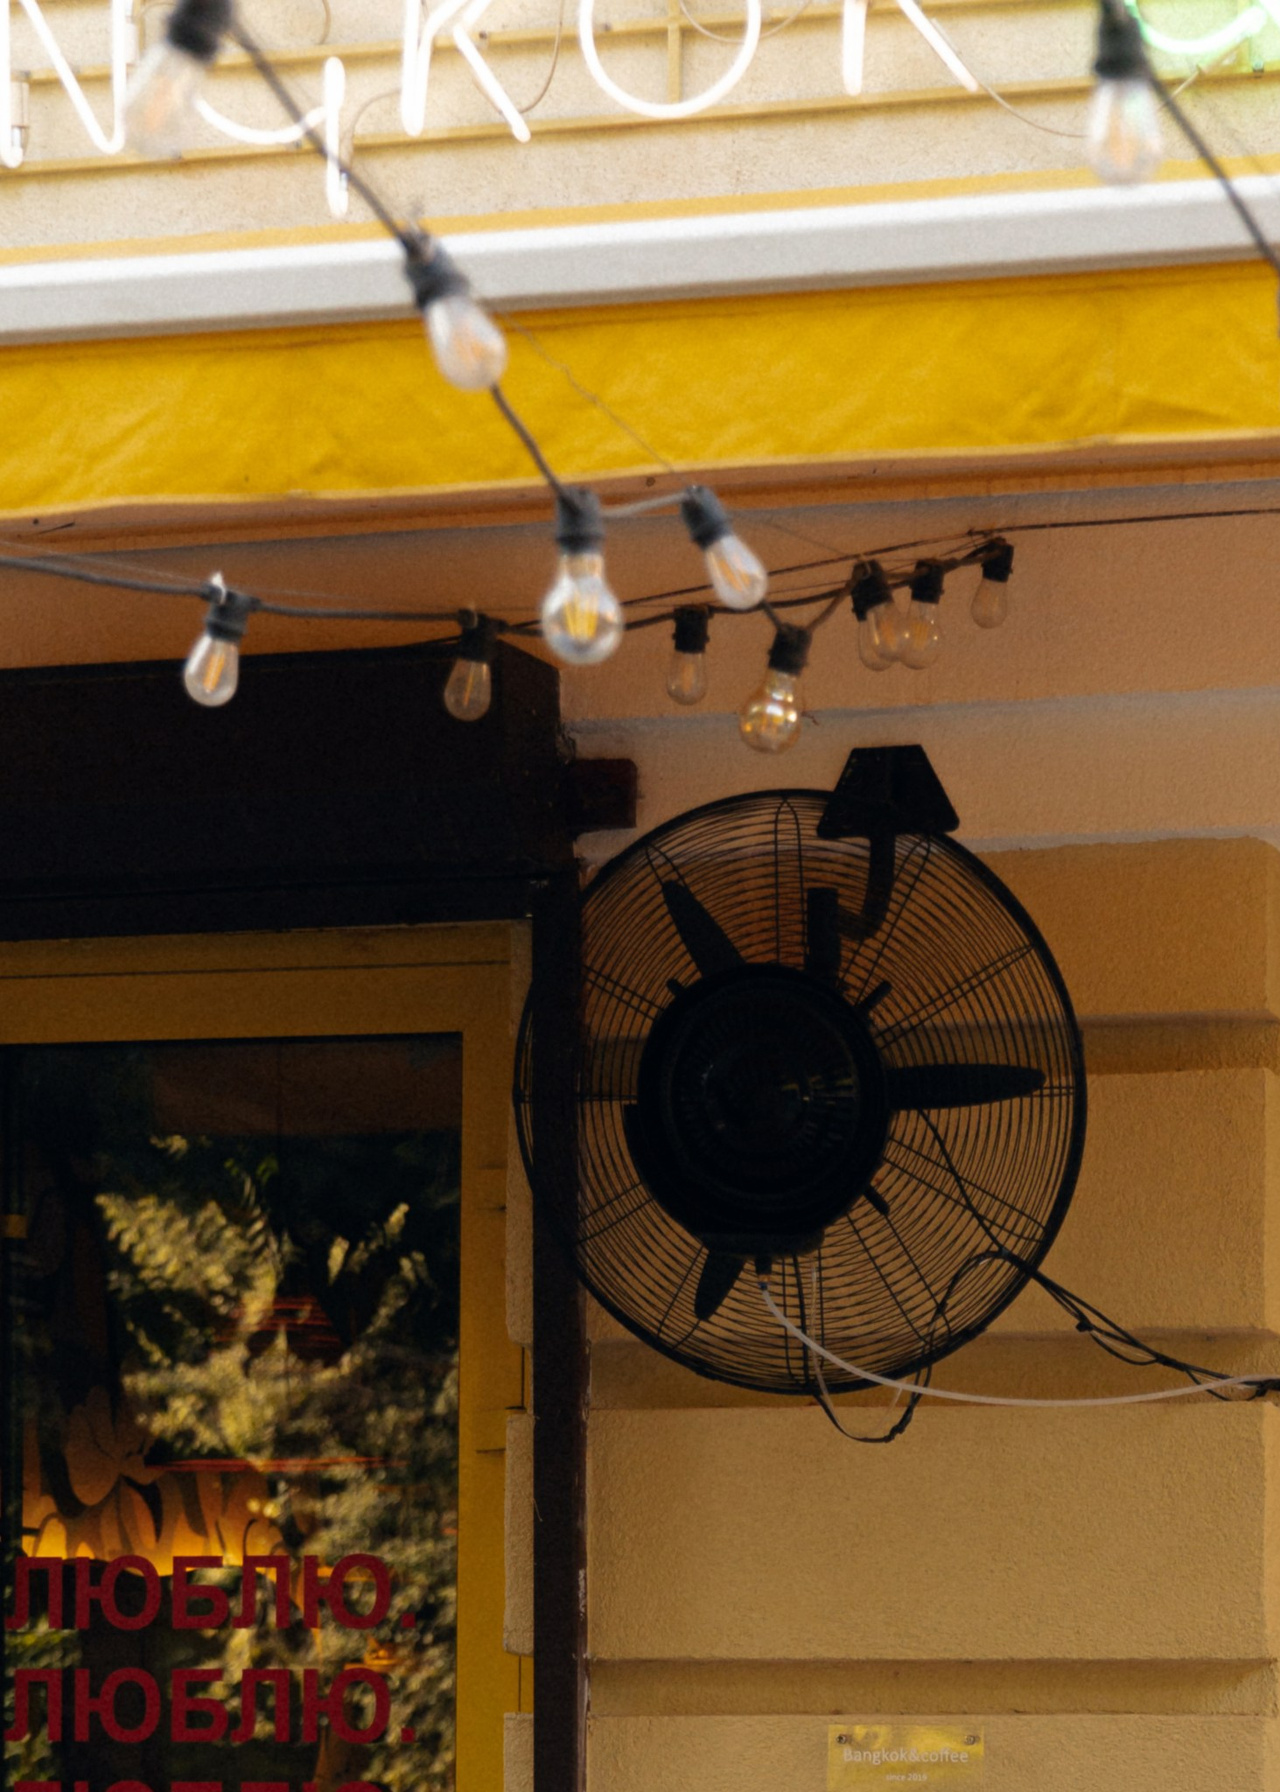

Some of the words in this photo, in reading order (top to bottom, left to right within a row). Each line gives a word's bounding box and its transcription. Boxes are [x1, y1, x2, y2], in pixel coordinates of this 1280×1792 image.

[4, 1554, 416, 1630] ЛЮБЛЮ.
[3, 1667, 416, 1743] ЛЮБЛЮ.
[843, 1747, 969, 1766] Bangkok&coffee
